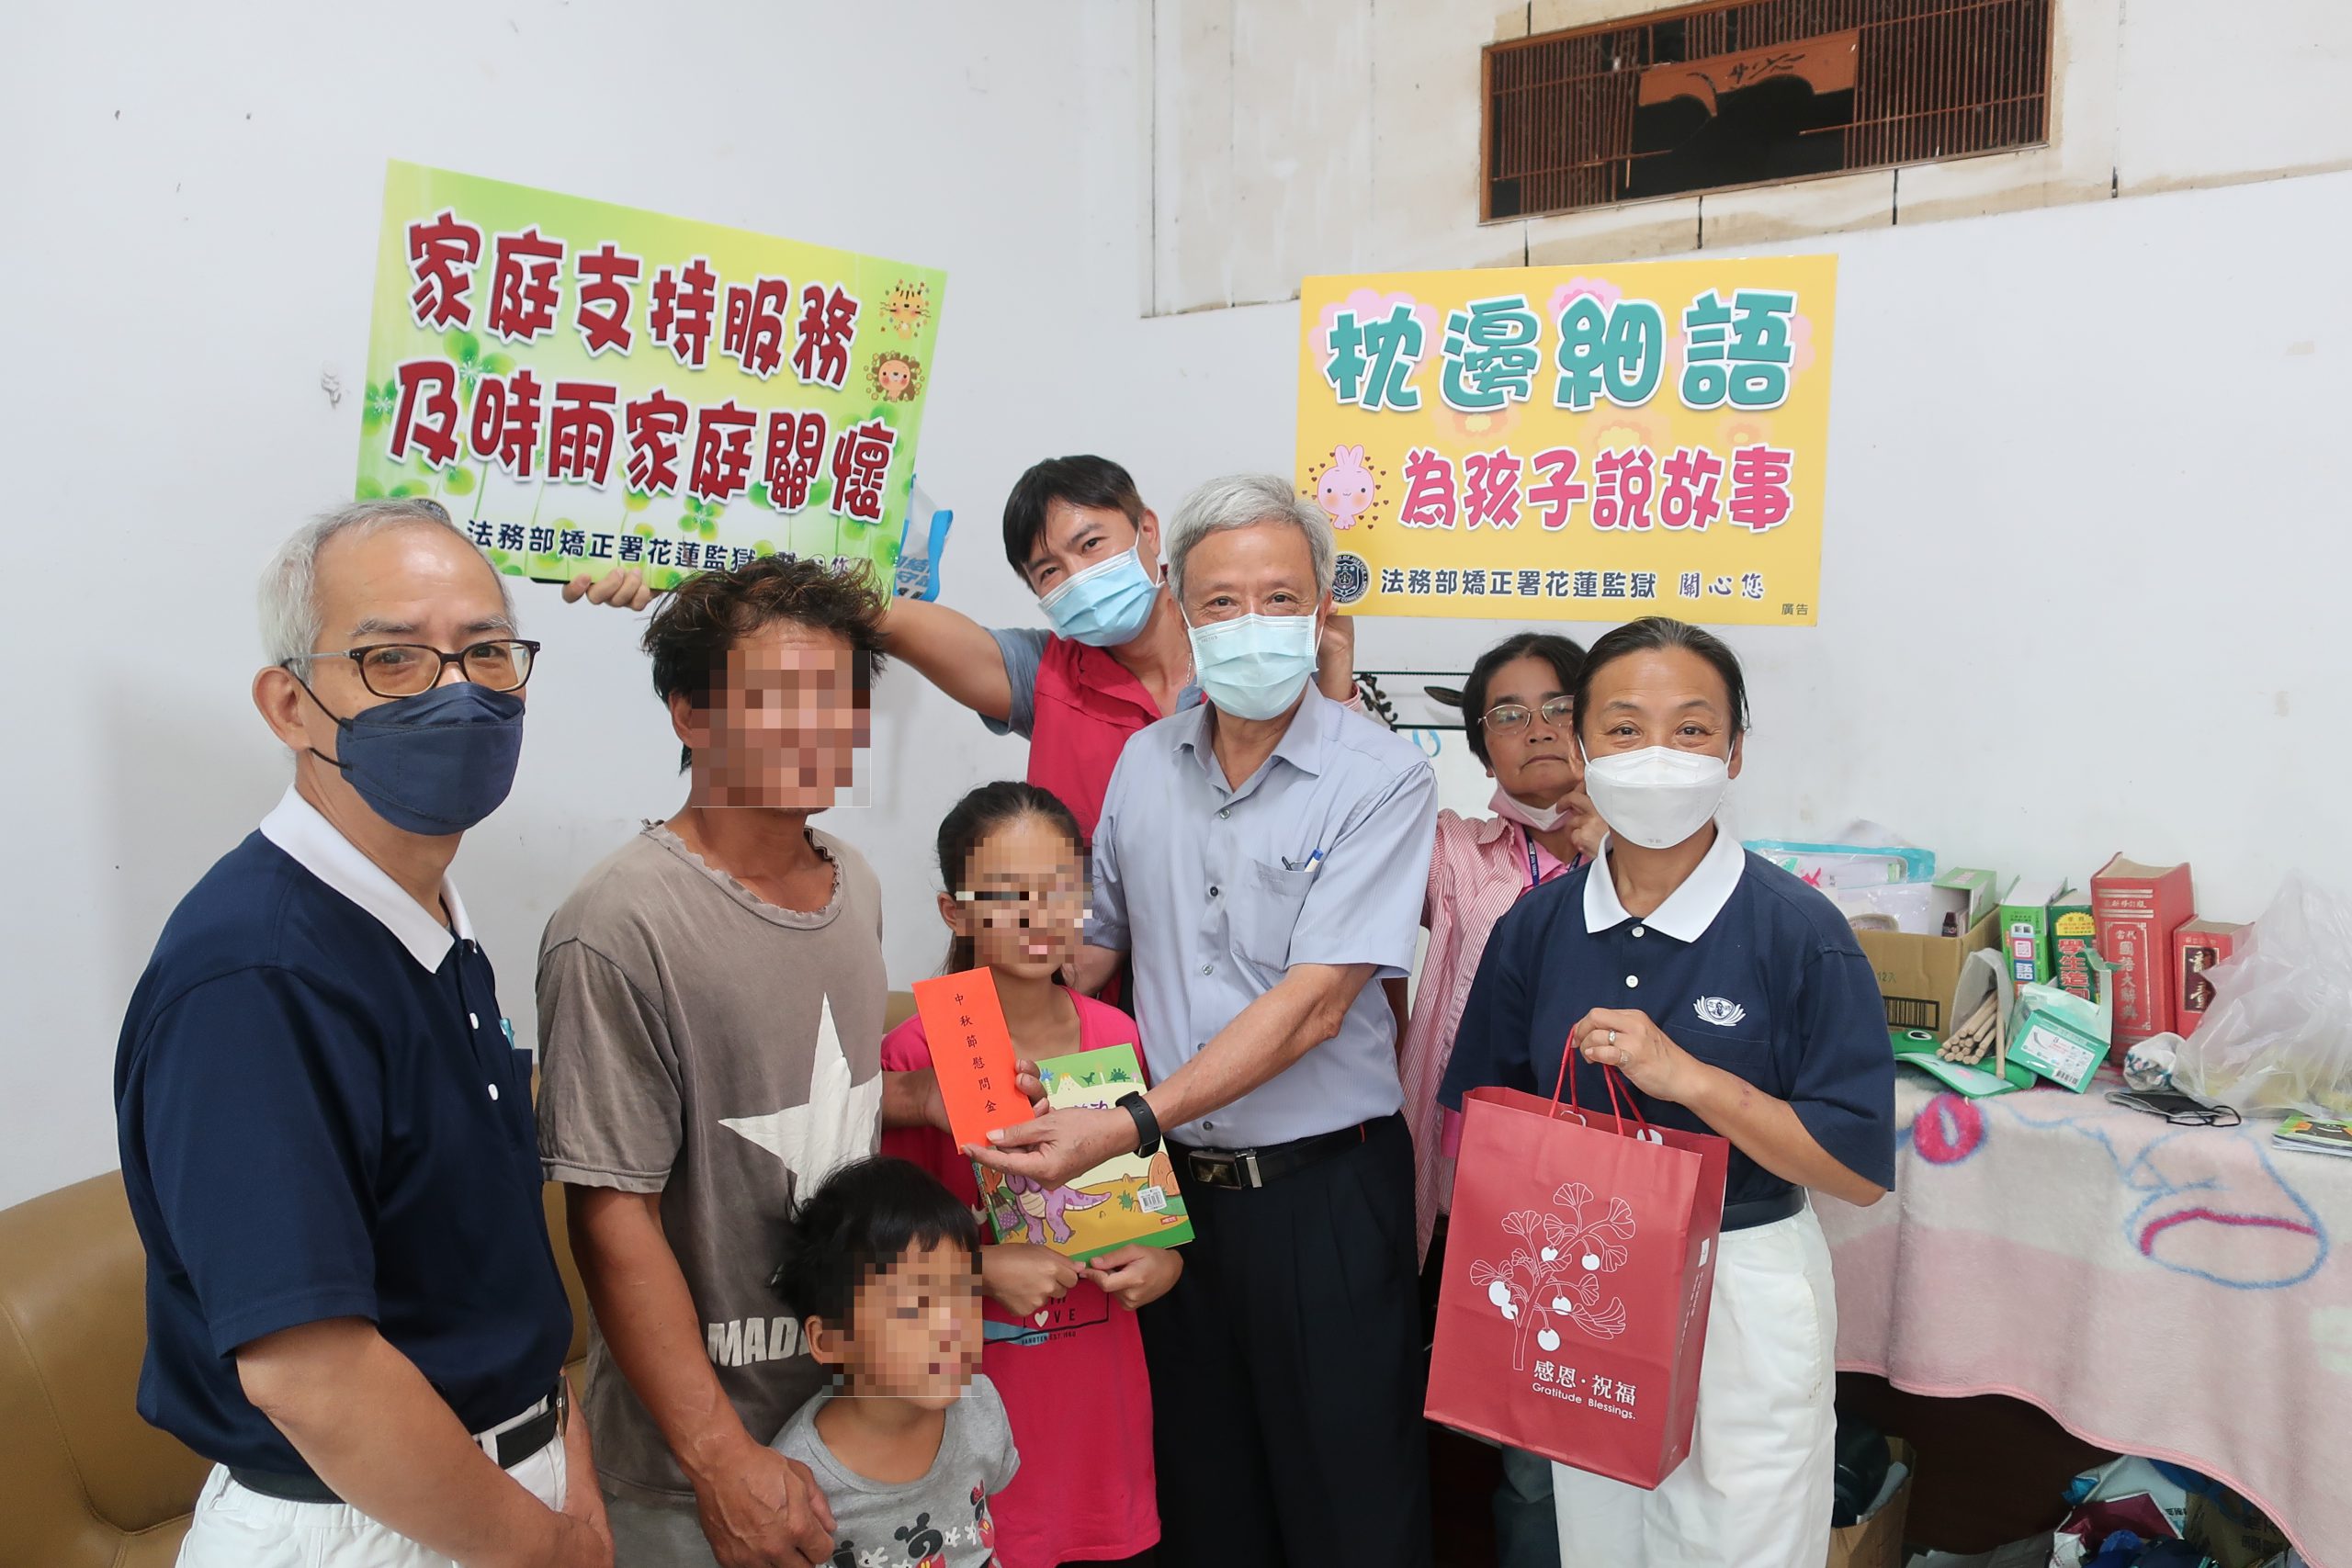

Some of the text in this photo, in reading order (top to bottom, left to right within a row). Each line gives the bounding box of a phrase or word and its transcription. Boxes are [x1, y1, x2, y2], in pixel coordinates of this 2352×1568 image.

[406, 209, 860, 391] 家庭支持服務
[1326, 290, 1796, 410] 枕邊細語
[389, 360, 898, 521] 及時雨家庭關懷
[1401, 446, 1792, 531] 為孩子說故事
[466, 519, 755, 573] 法務部矯正署花蓮監獄
[1381, 568, 1764, 600] 法務部矯正署花蓮監獄 關心您
[1781, 603, 1809, 615] 廣告
[954, 992, 997, 1113] 中秋節慰問金
[1532, 1382, 1636, 1420] Gratitude Blessings.
